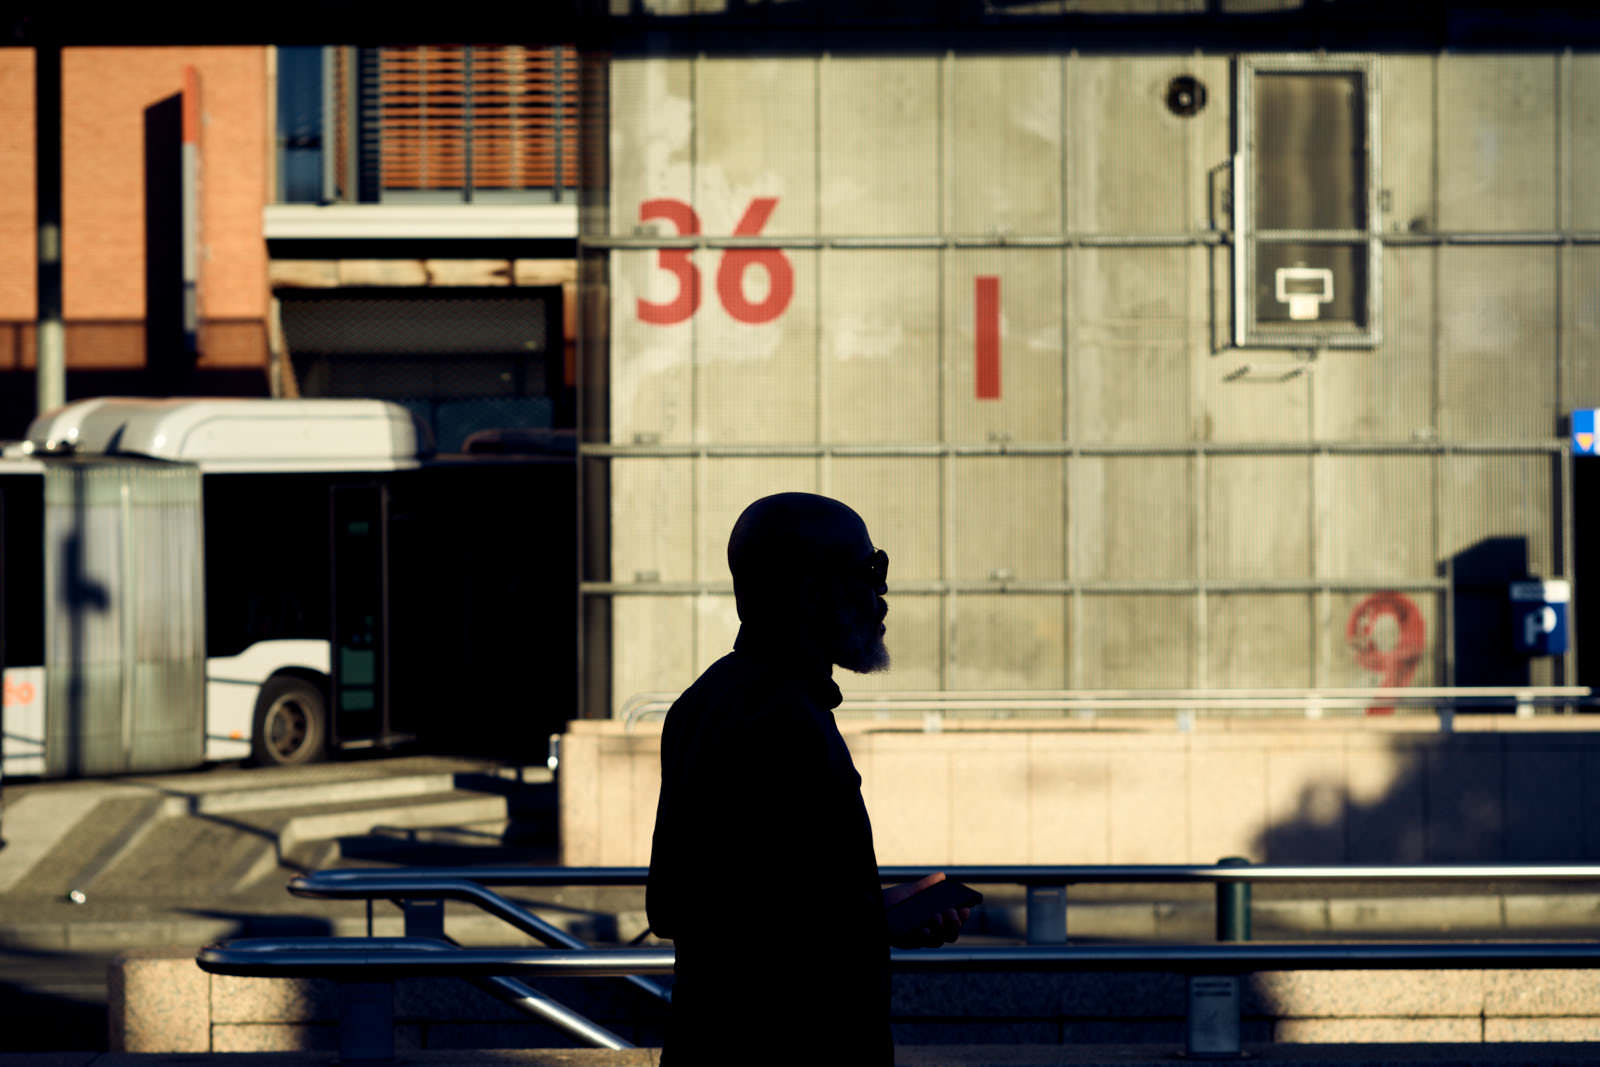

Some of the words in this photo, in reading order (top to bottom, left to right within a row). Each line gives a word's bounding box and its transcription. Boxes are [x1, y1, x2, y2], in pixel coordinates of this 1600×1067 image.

[636, 196, 795, 326] 36
[1345, 590, 1426, 717] 9
[1523, 605, 1558, 648] P
